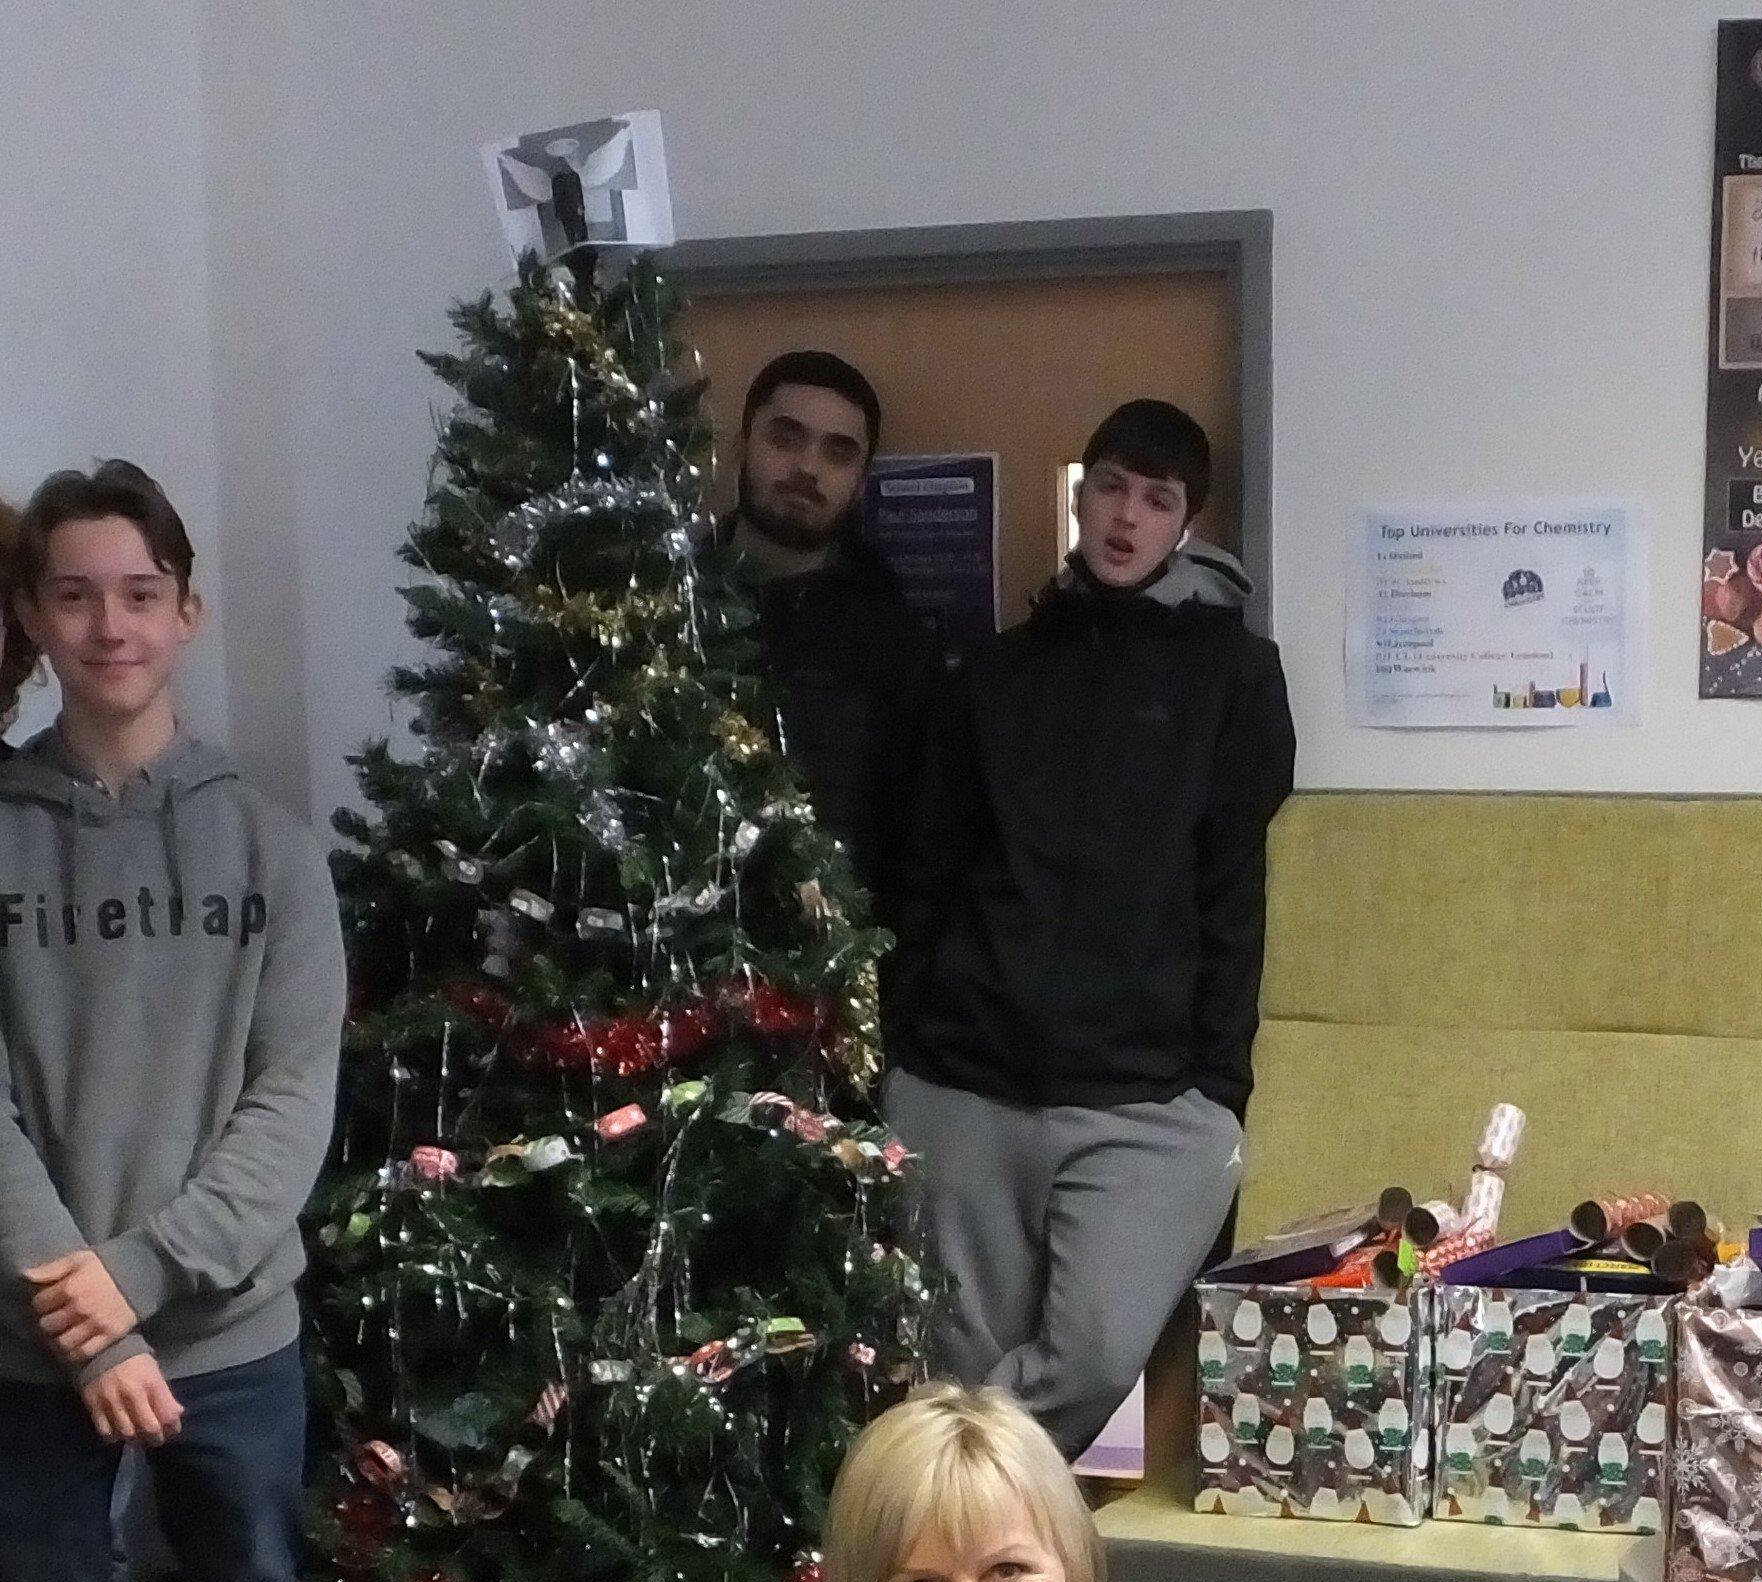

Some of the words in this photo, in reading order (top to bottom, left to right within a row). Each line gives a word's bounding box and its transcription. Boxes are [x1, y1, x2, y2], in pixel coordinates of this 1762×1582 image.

[1381, 524, 1406, 541] Top
[1411, 523, 1499, 539] Universities
[1505, 522, 1529, 536] For
[1533, 520, 1612, 537] Chemistry
